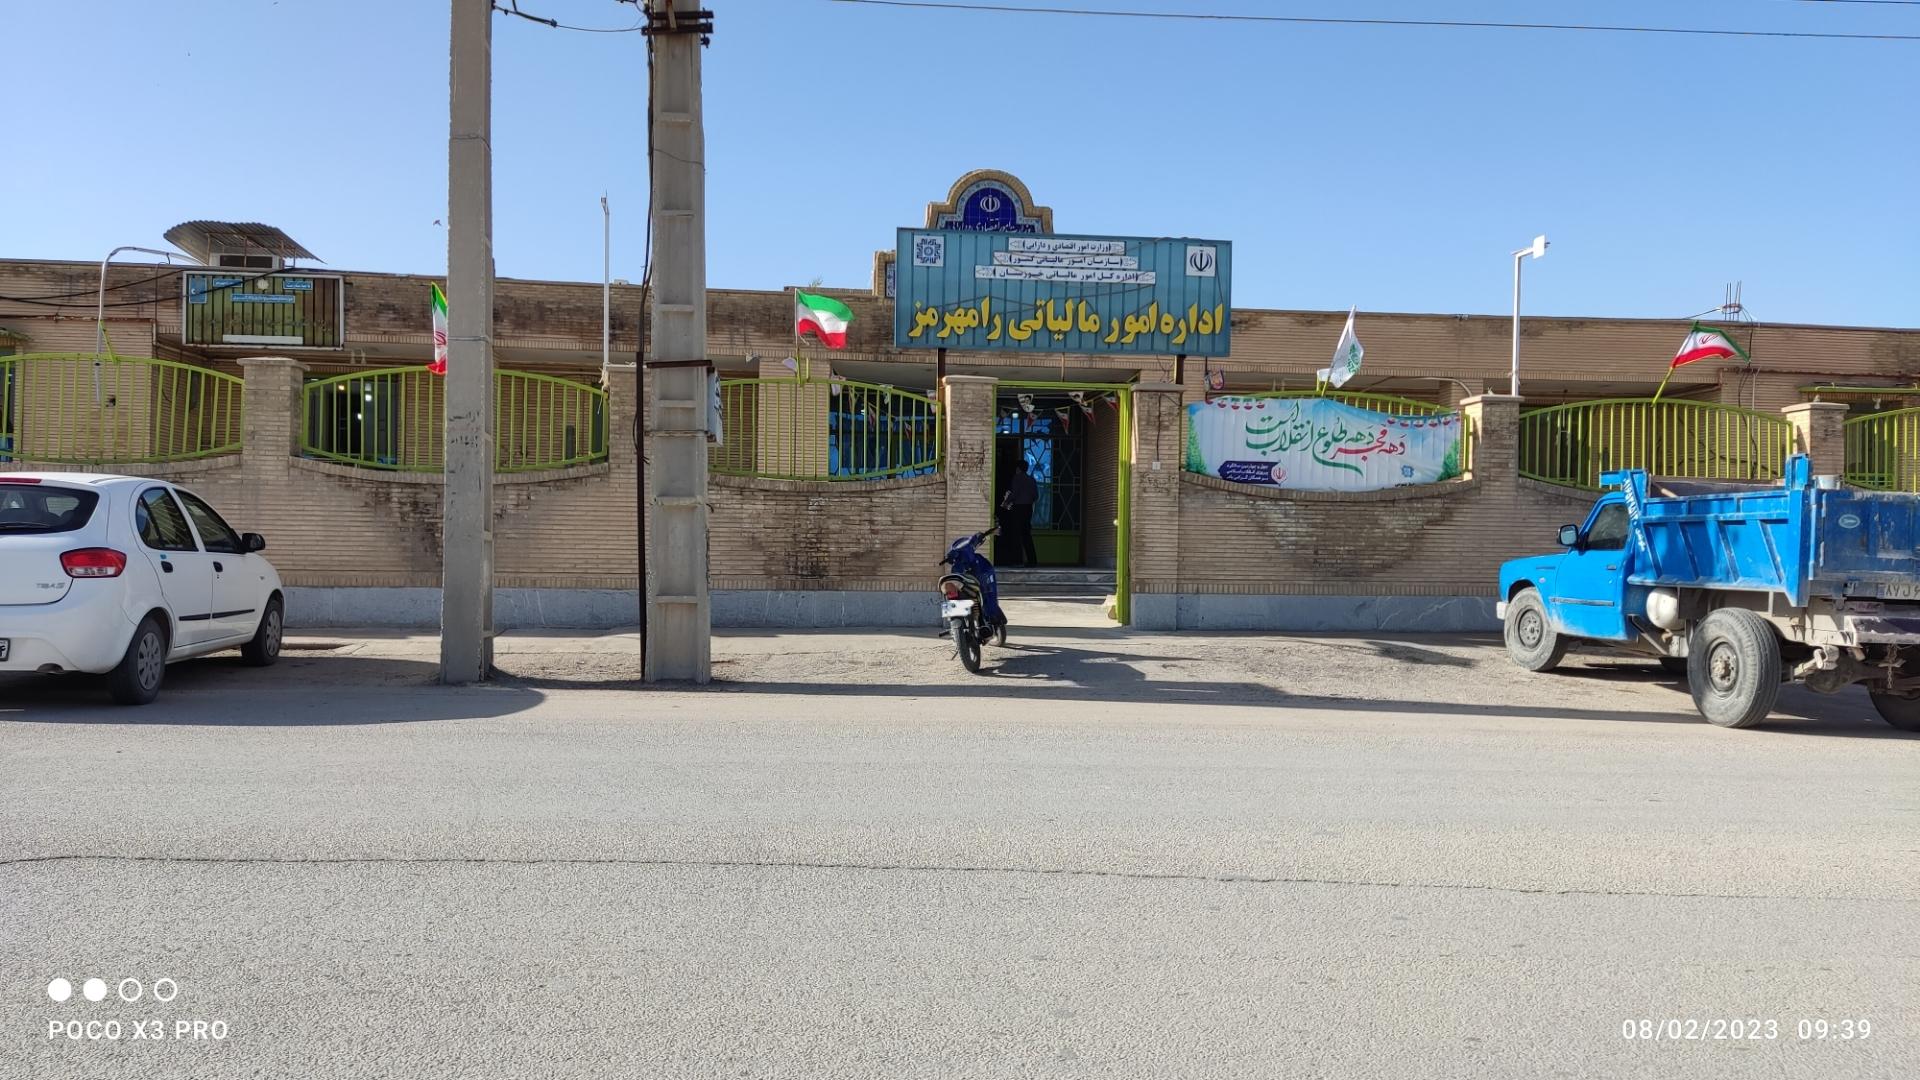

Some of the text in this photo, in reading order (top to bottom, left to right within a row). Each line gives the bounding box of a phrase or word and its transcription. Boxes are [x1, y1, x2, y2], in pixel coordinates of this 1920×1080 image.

[908, 295, 1224, 345] اداره امور مالیاتی رامهرمز
[1245, 400, 1300, 434] است
[1245, 419, 1314, 456] انقلاب
